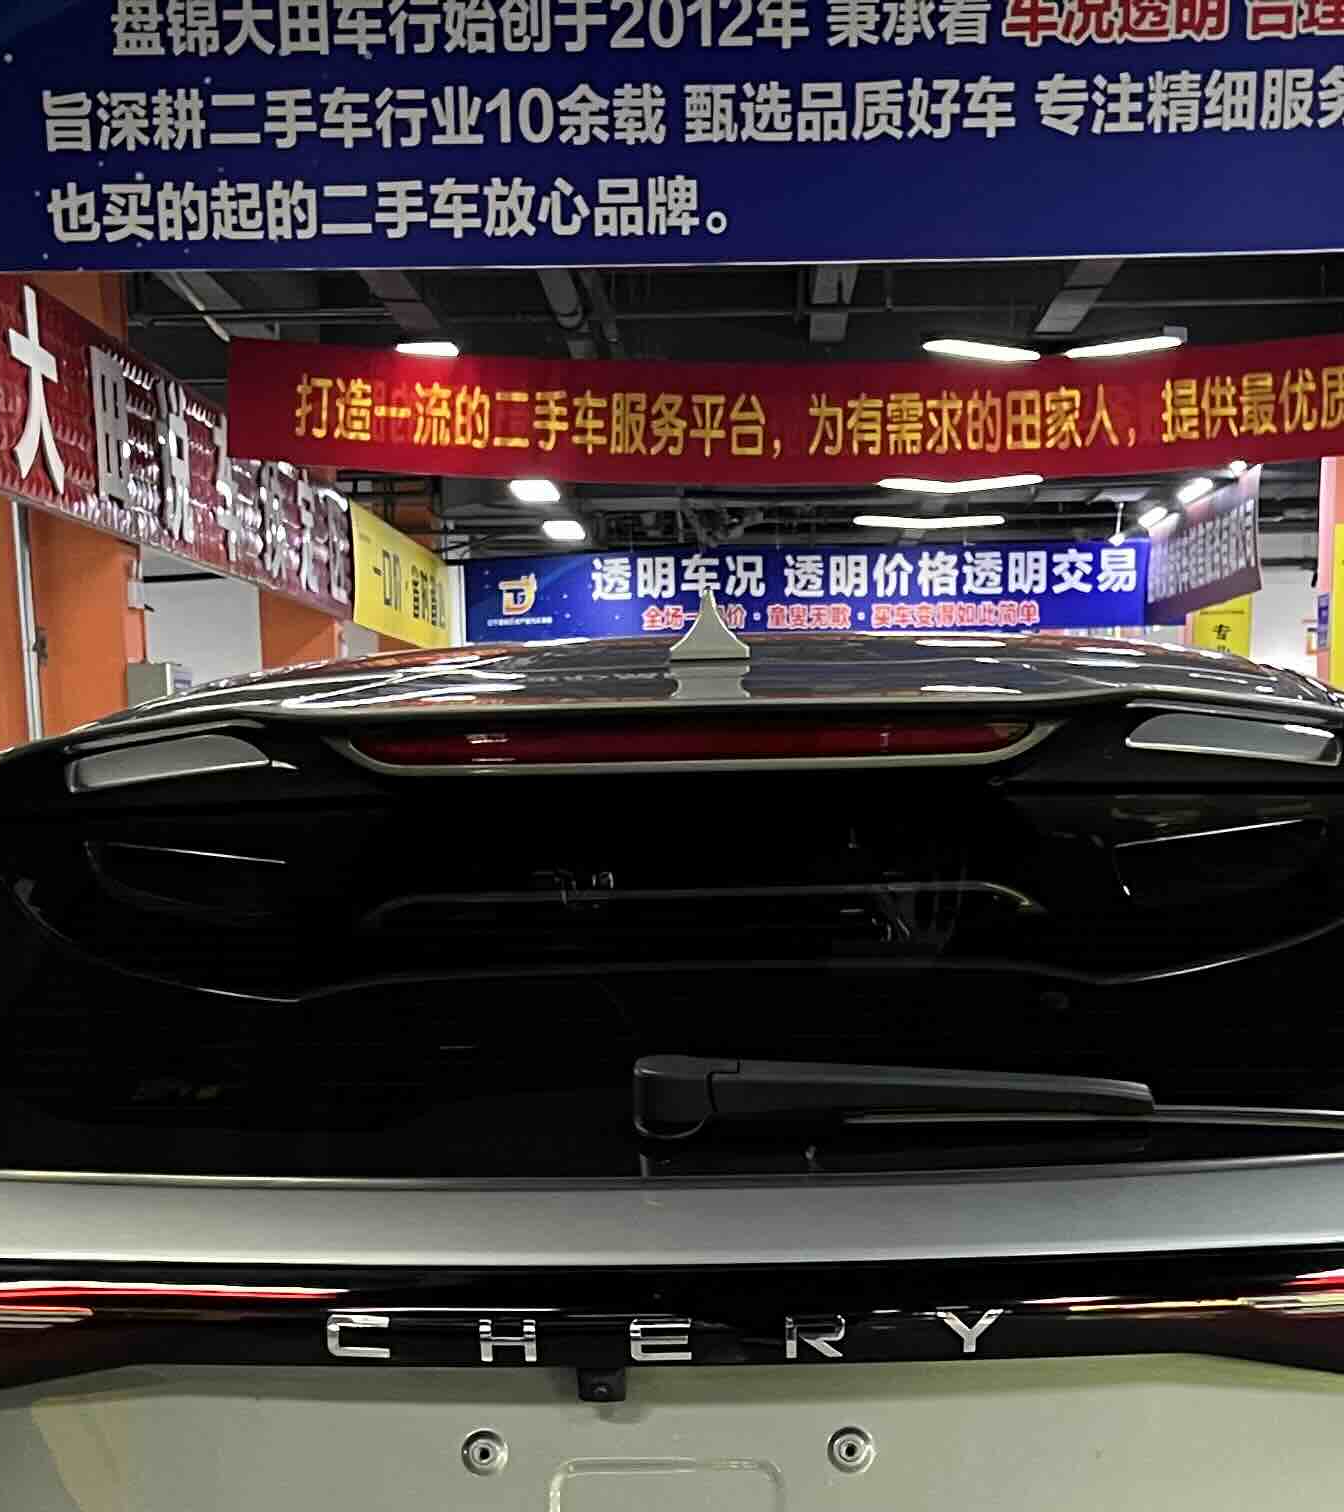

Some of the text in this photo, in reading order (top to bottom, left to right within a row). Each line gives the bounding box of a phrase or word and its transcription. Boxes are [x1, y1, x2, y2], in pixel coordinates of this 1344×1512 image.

[43, 83, 666, 153] 旨深耕二手车行业10余载
[684, 74, 1016, 144] 甄选品质好车
[46, 176, 729, 244] 也买的起的二手车放心品牌。
[591, 555, 767, 600] 透明车况
[783, 548, 1137, 600] 透明价格透明交易
[324, 1308, 1005, 1364] CHERY
